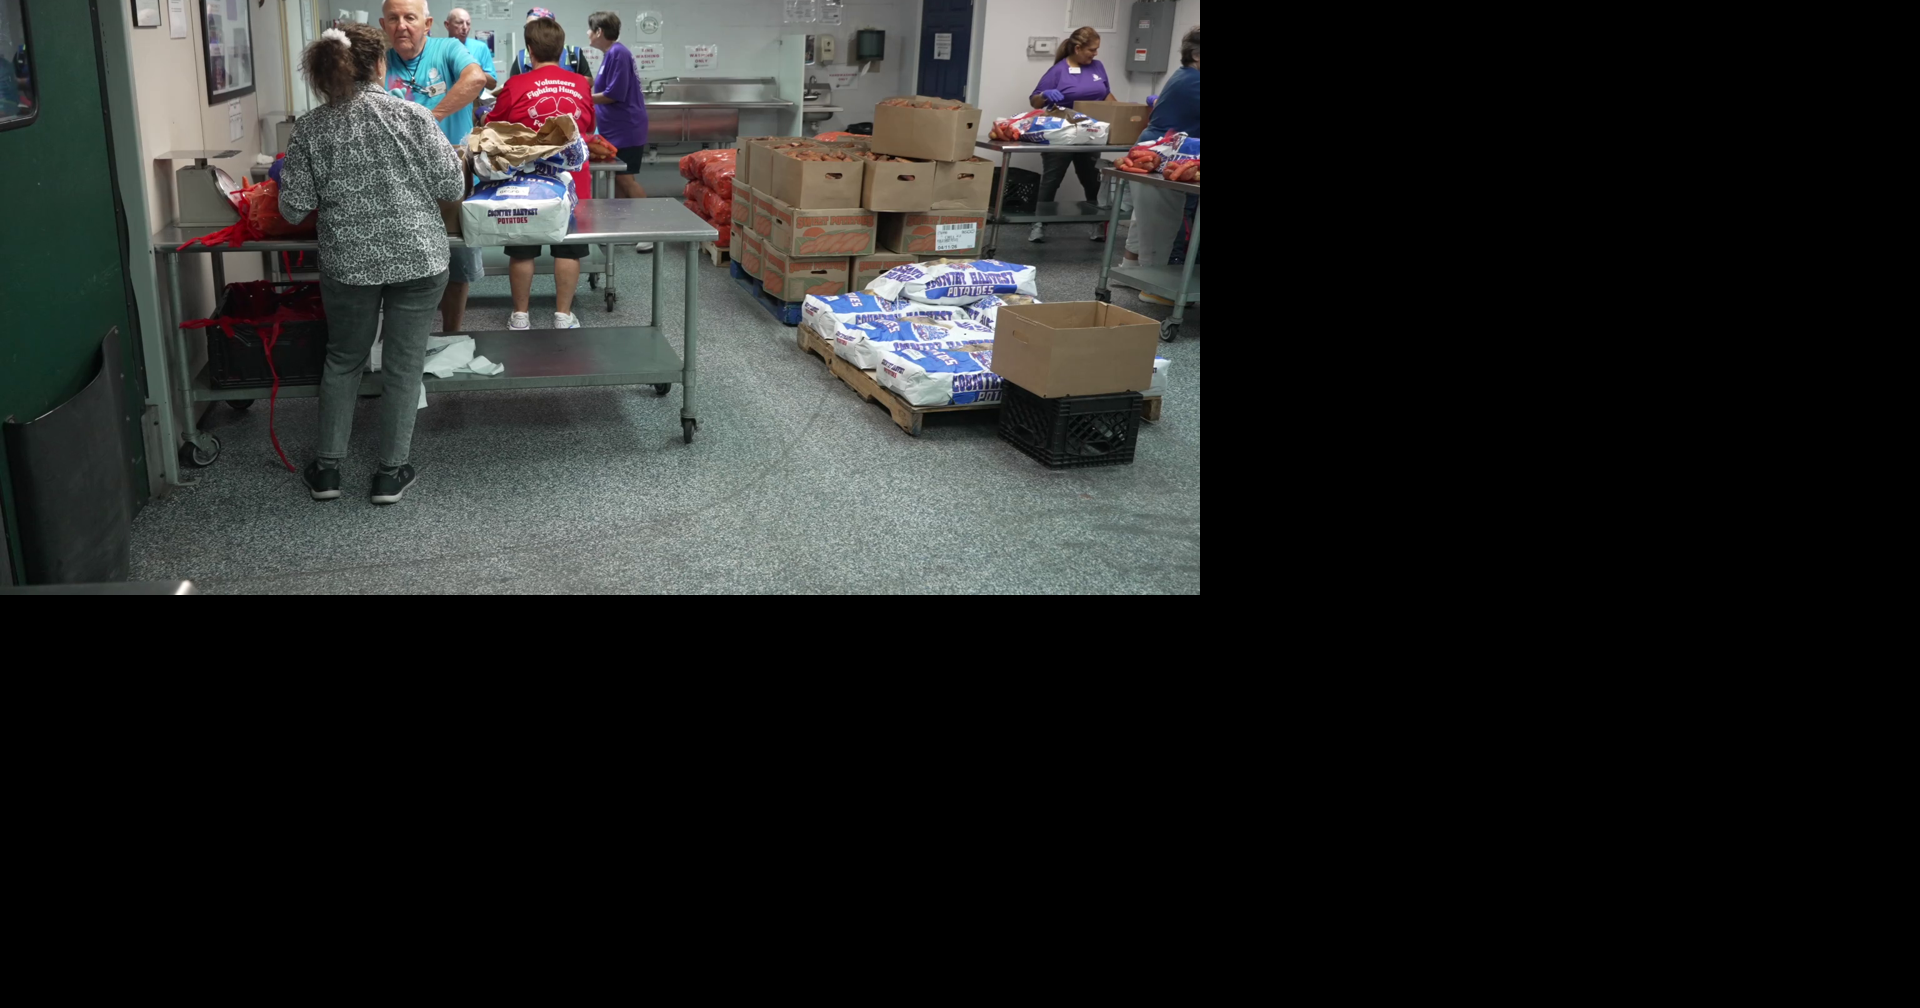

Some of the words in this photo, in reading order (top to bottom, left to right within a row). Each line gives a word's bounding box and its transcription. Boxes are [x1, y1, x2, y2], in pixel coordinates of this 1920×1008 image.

[534, 79, 576, 88] Volunteers
[526, 86, 558, 99] Fighting
[559, 86, 583, 100] Hunger
[487, 208, 512, 218] COUNTRY
[497, 217, 528, 225] POTATOES
[796, 216, 829, 229] SWEET
[830, 215, 874, 228] POTATOES
[969, 271, 1016, 286] HARVEST
[947, 285, 995, 297] POTATOES
[952, 373, 1004, 393] COUNTR
